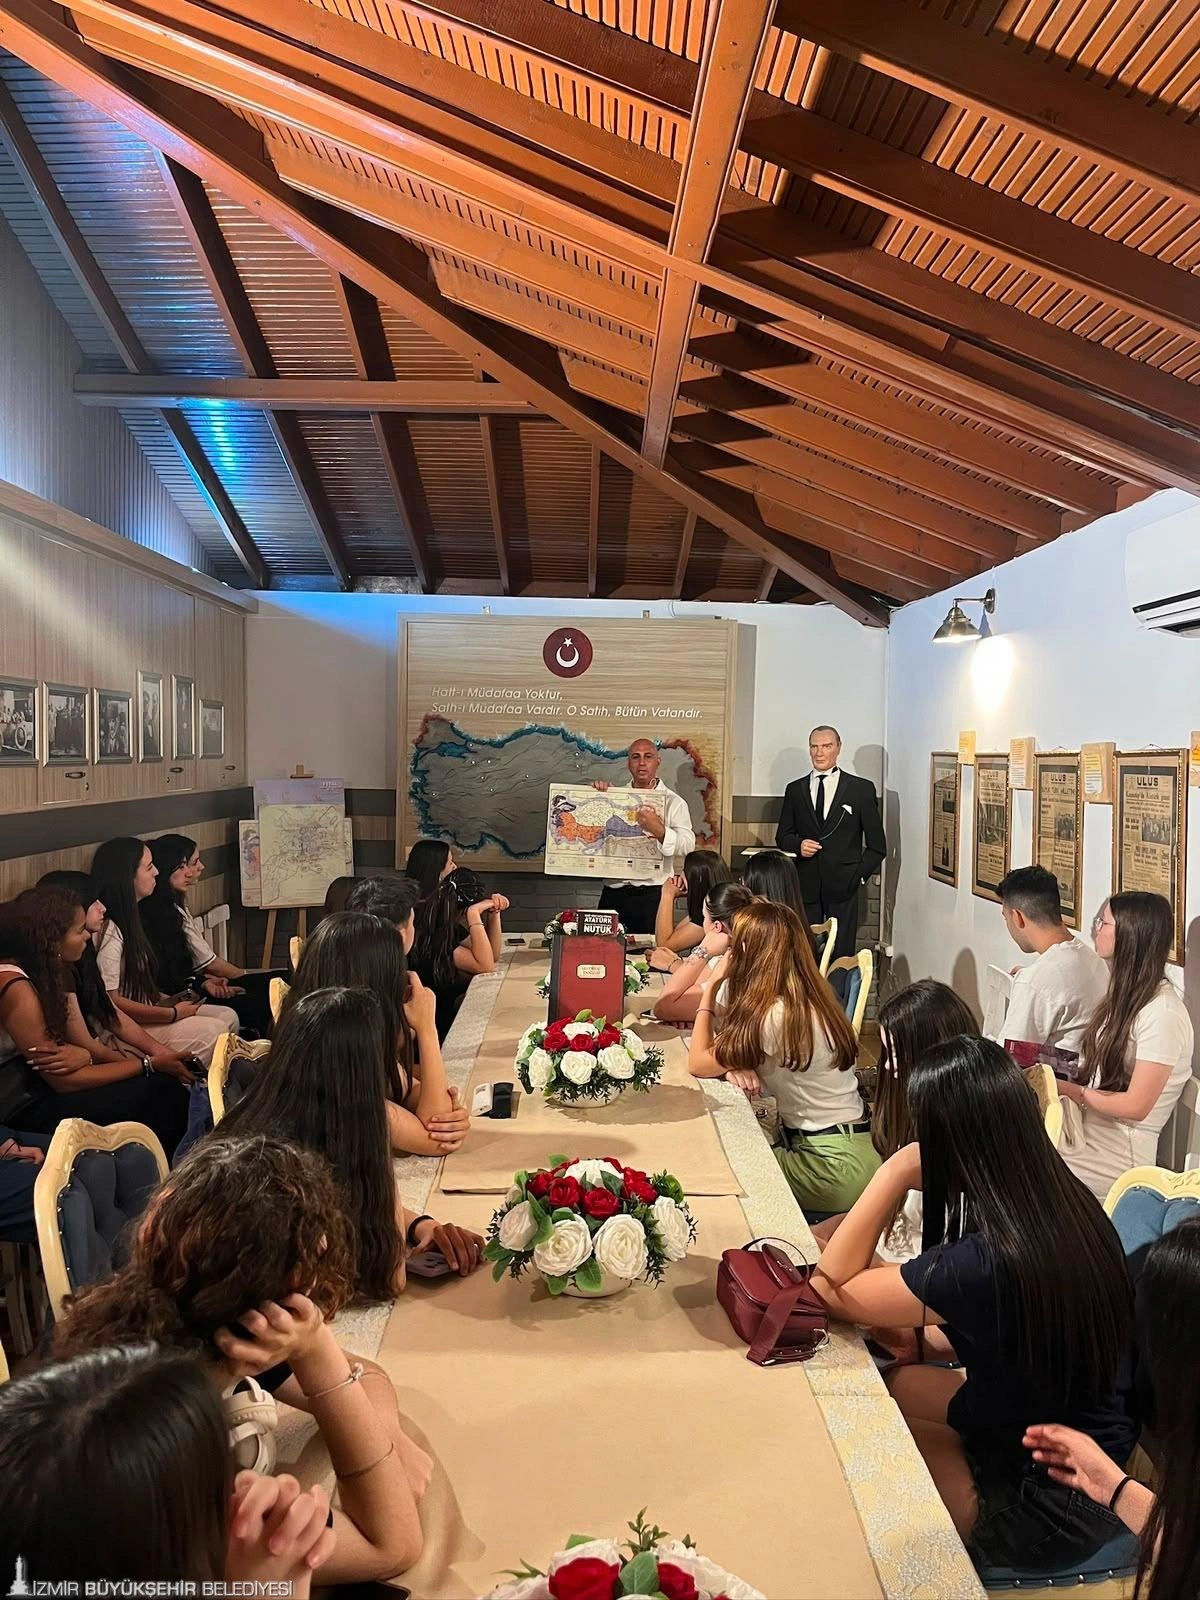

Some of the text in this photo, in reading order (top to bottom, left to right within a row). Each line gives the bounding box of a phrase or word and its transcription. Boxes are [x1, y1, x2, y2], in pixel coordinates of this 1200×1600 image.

[432, 687, 562, 701] Hatt-ı Müdafaa Yoktur,
[431, 702, 703, 719] Sath-ı Müdafaa Vardır. O Satıh, Bütün Vatandır.
[1136, 776, 1159, 787] ULUS
[584, 925, 613, 934] NUTUK
